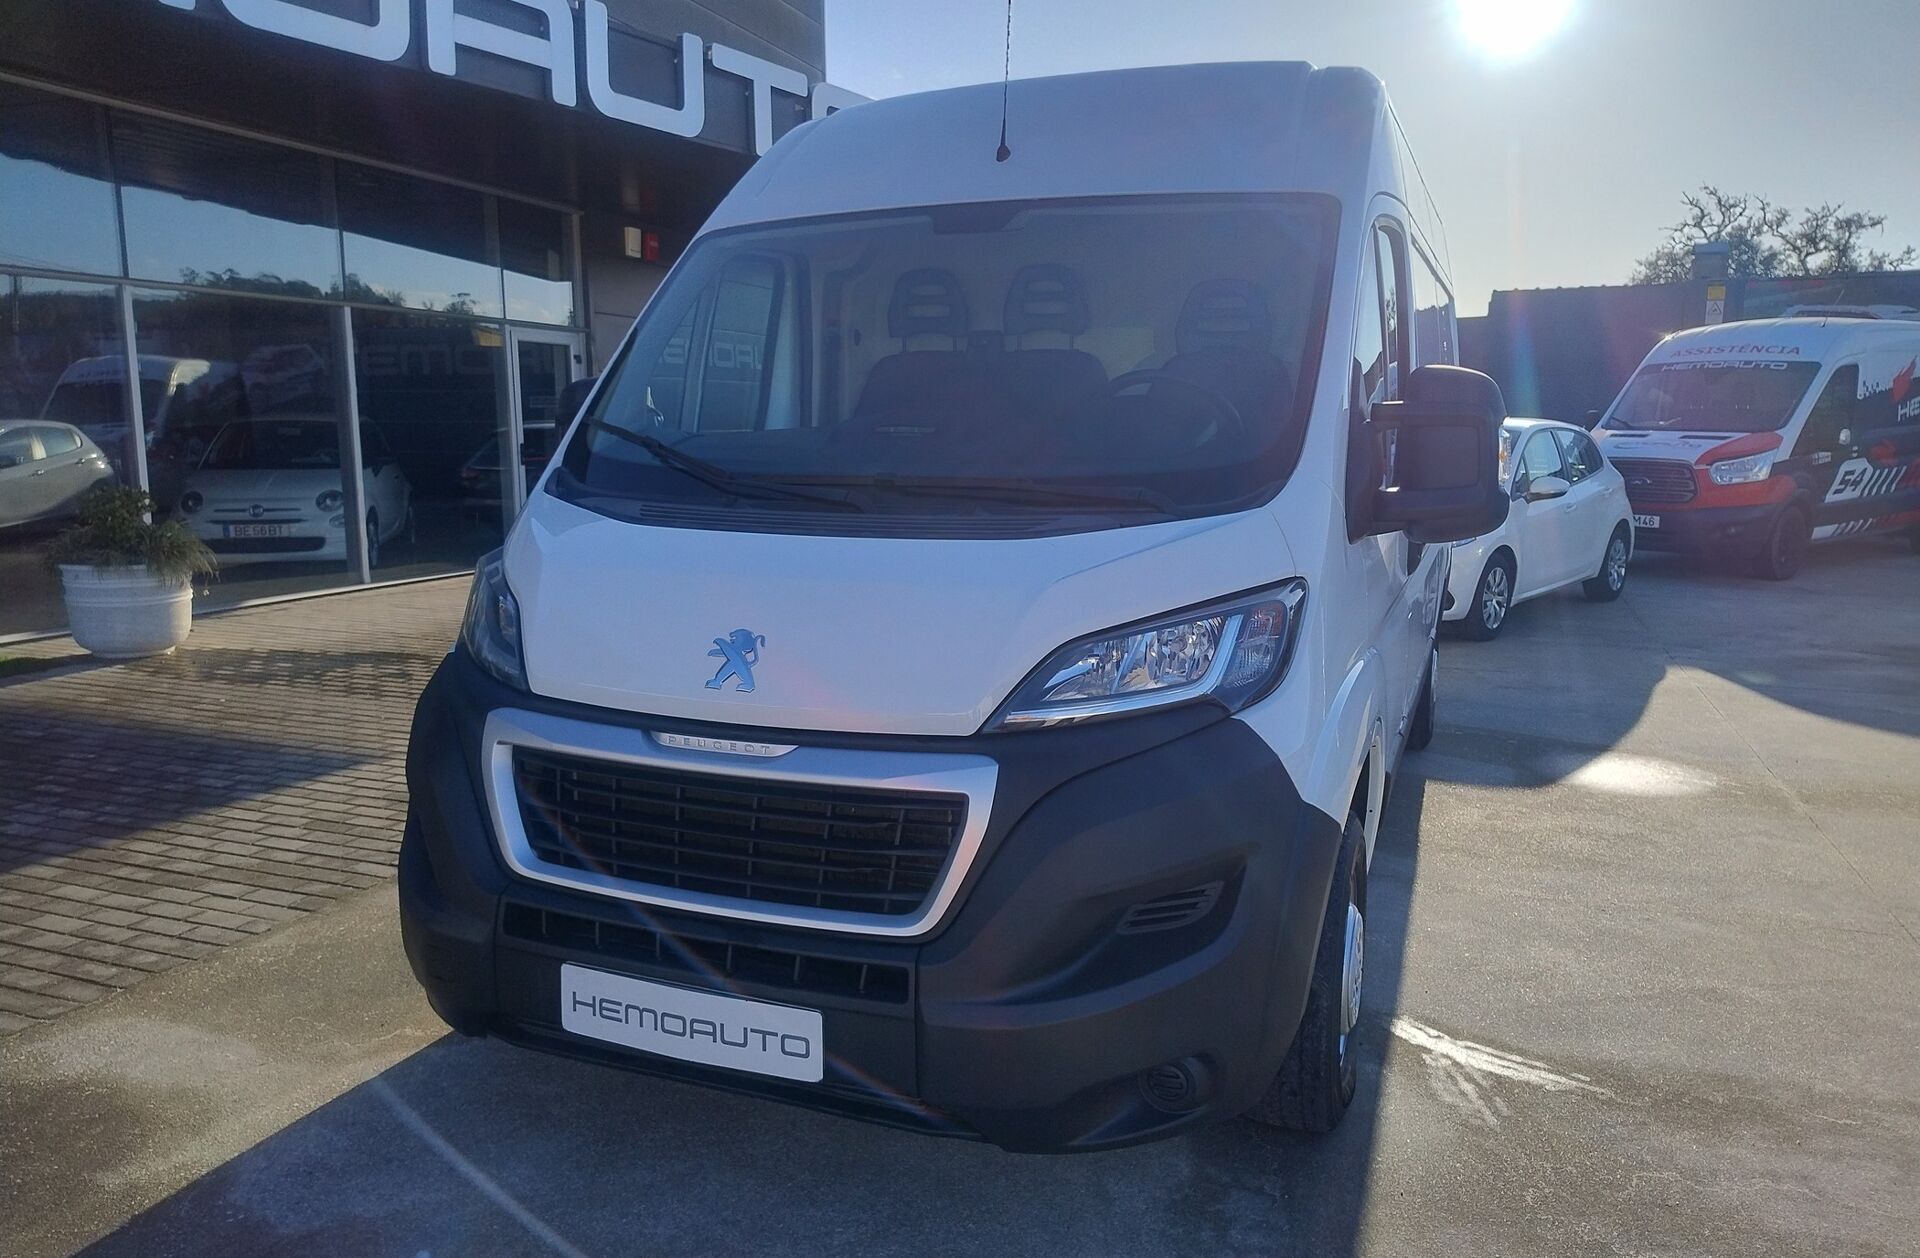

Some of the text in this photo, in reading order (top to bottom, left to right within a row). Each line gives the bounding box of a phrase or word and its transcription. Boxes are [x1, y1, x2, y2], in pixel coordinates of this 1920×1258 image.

[1661, 361, 1788, 372] HEMOAUTO
[1833, 467, 1868, 496] 54
[668, 735, 770, 755] PEUGEOT
[572, 991, 810, 1058] HEMOAUTO
